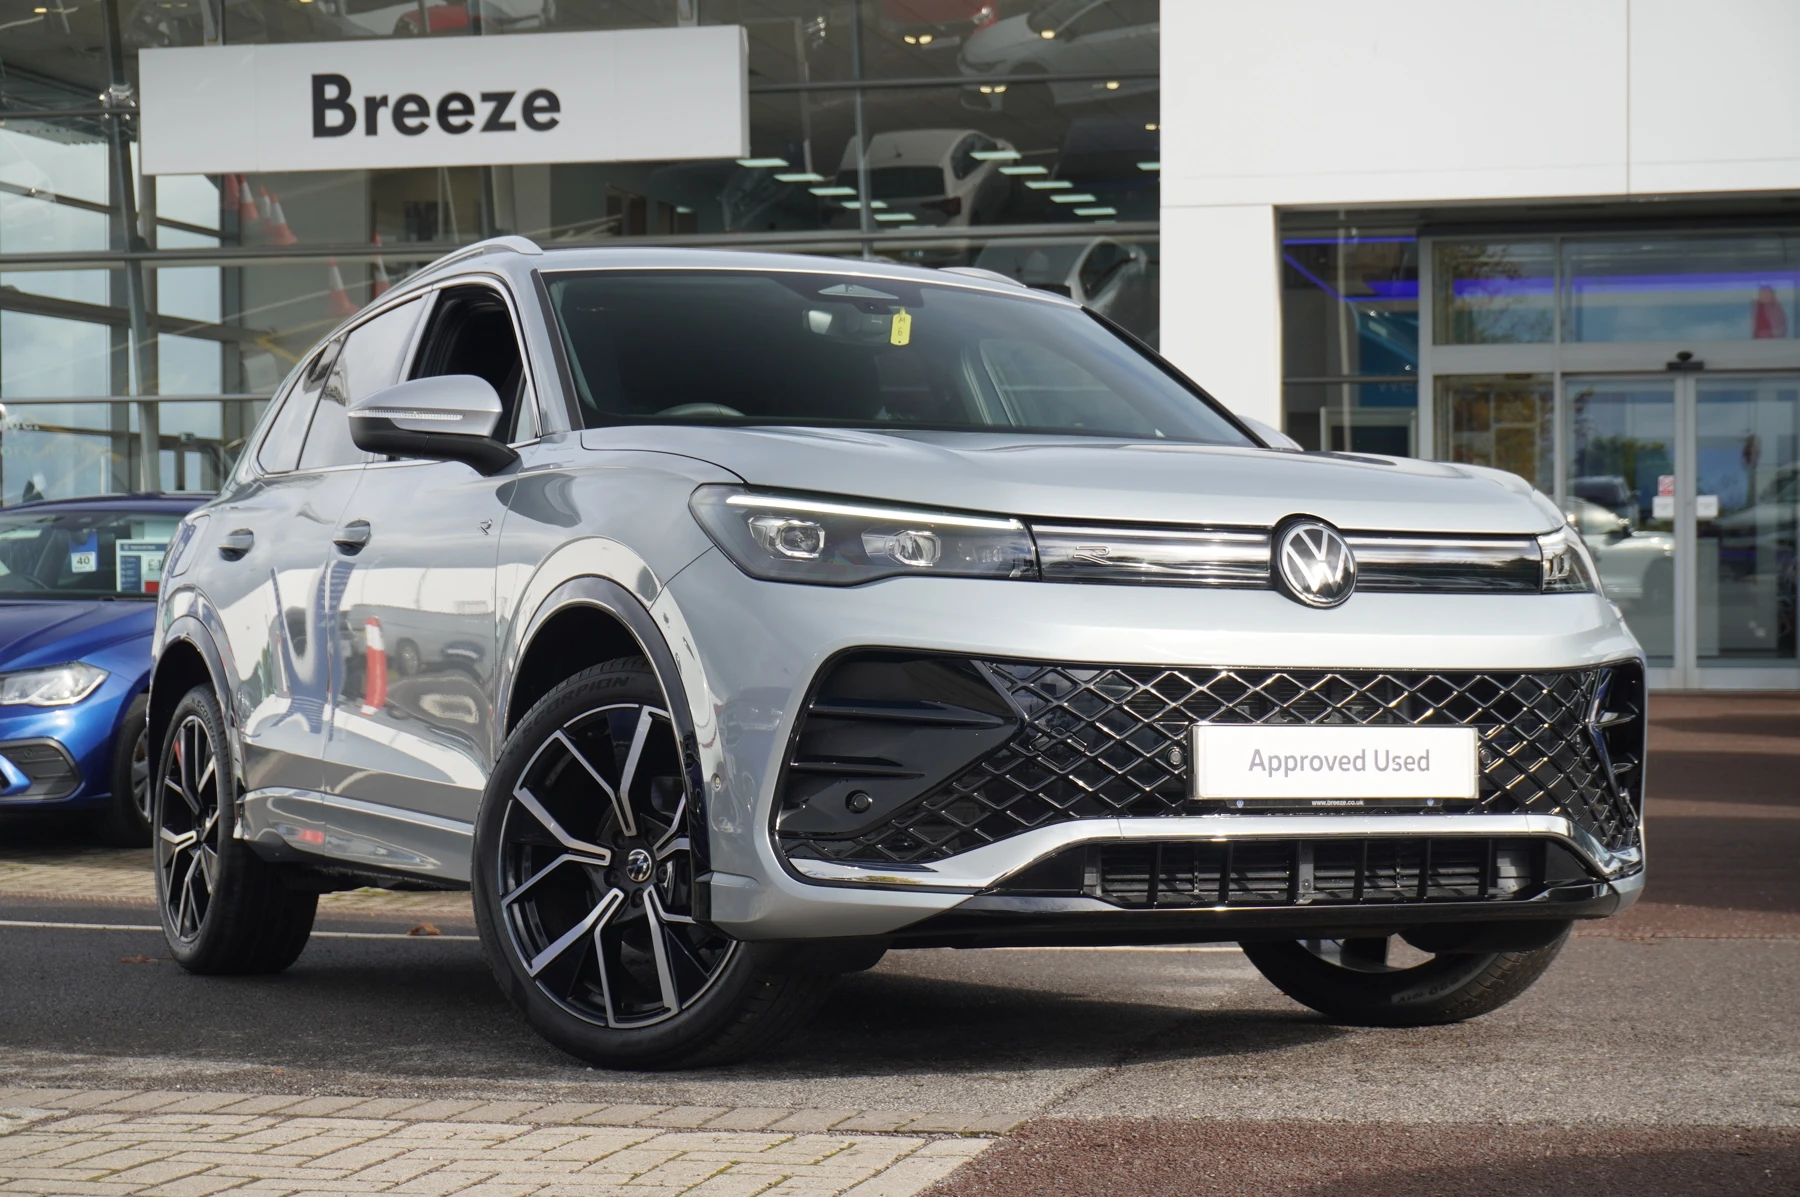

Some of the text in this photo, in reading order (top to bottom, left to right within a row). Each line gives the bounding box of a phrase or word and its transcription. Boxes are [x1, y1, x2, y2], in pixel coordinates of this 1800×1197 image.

[311, 73, 561, 138] Breeze
[76, 555, 91, 565] 40
[1248, 748, 1431, 778] Approved Used
[1311, 799, 1364, 807] www.breeze.co.uk
